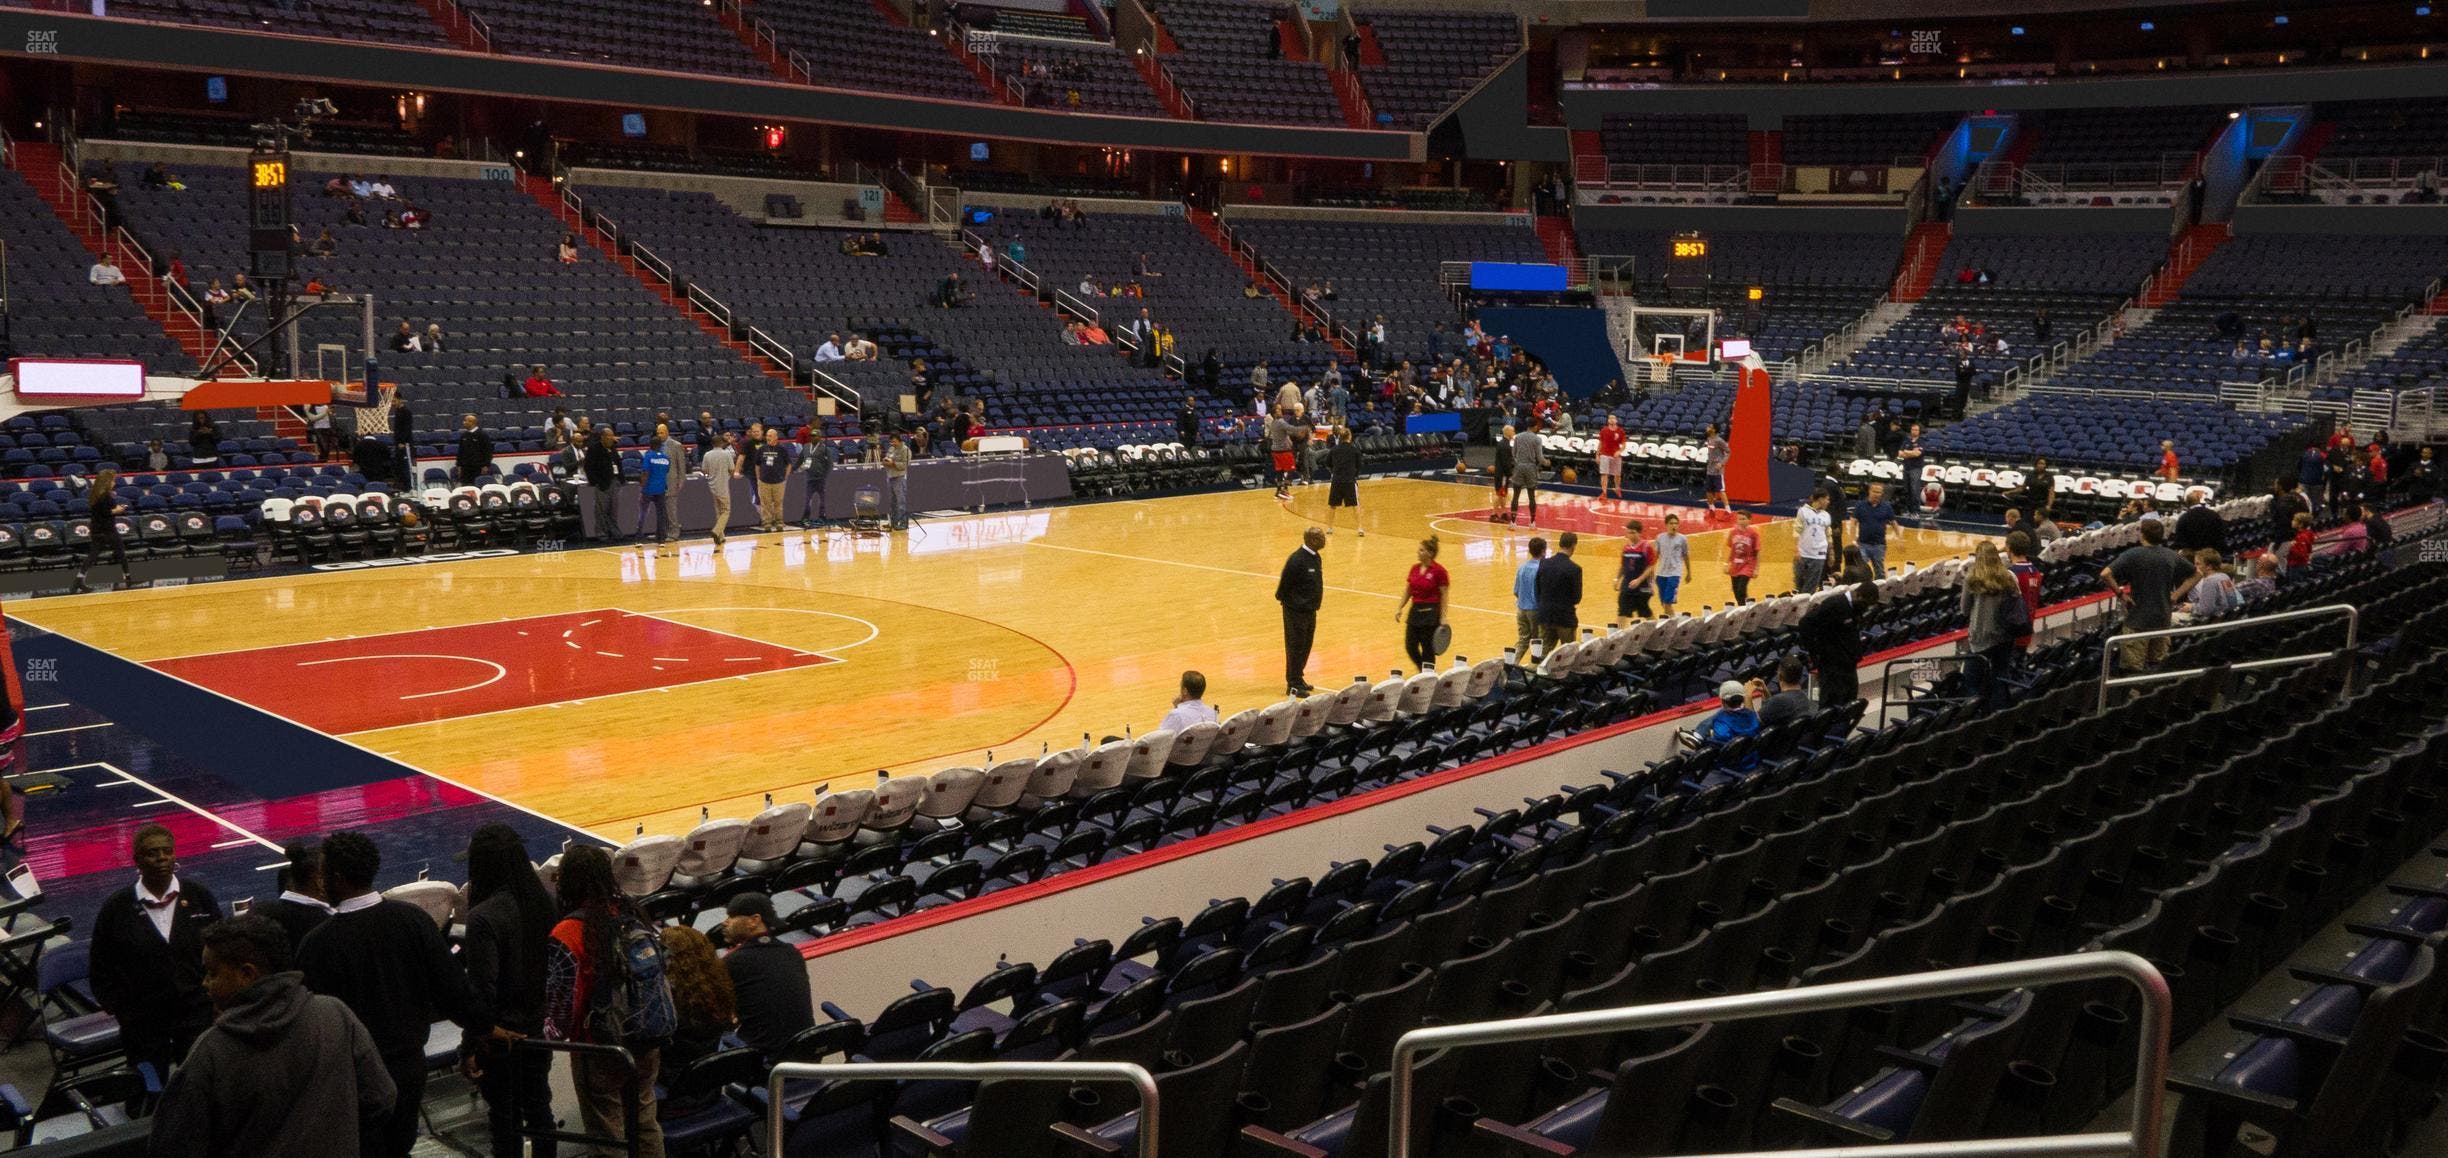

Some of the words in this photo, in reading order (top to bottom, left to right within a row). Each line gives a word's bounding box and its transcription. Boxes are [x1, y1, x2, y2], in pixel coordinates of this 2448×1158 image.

[485, 168, 510, 181] 100
[863, 190, 880, 202] 121
[1165, 205, 1182, 216] 120
[1674, 243, 1705, 257] 38:57
[311, 549, 520, 571] GEICO
